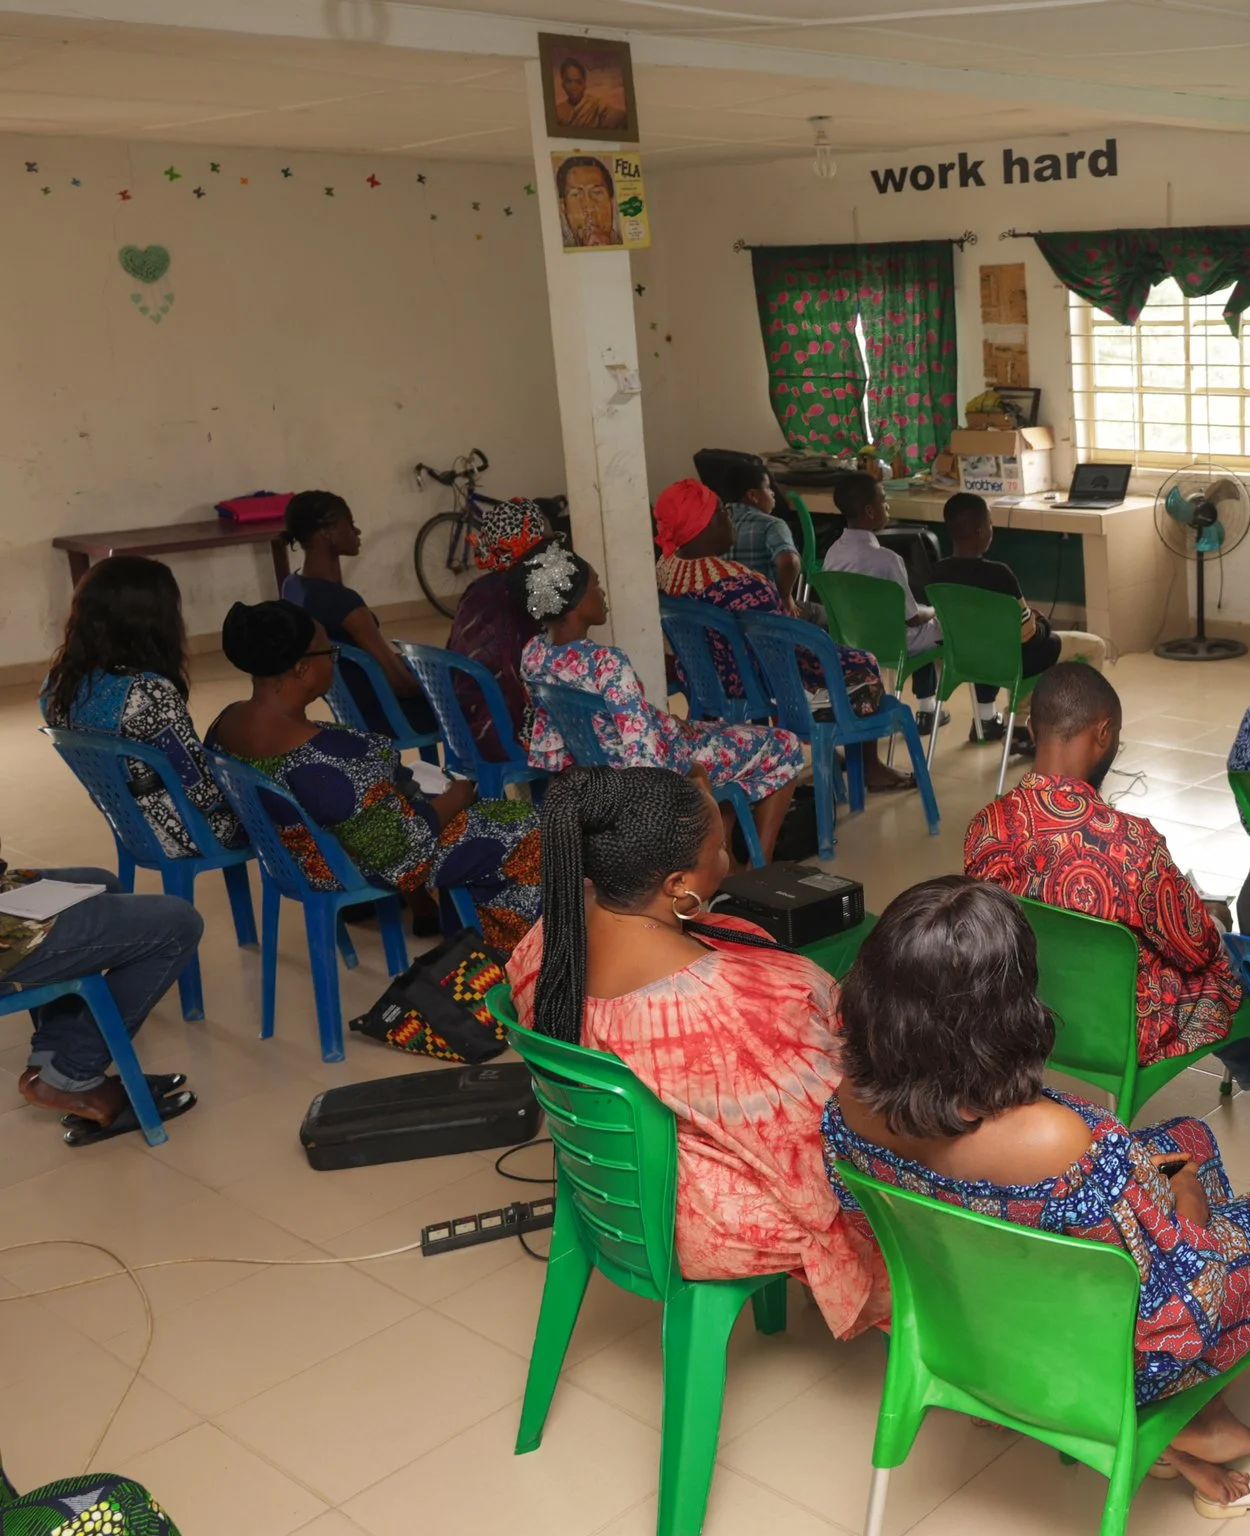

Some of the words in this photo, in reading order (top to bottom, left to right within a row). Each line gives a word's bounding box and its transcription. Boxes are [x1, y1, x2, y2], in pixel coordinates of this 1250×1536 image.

[615, 158, 640, 178] FELA
[870, 152, 986, 194] work
[1002, 138, 1118, 185] hard
[964, 479, 1003, 492] brother
